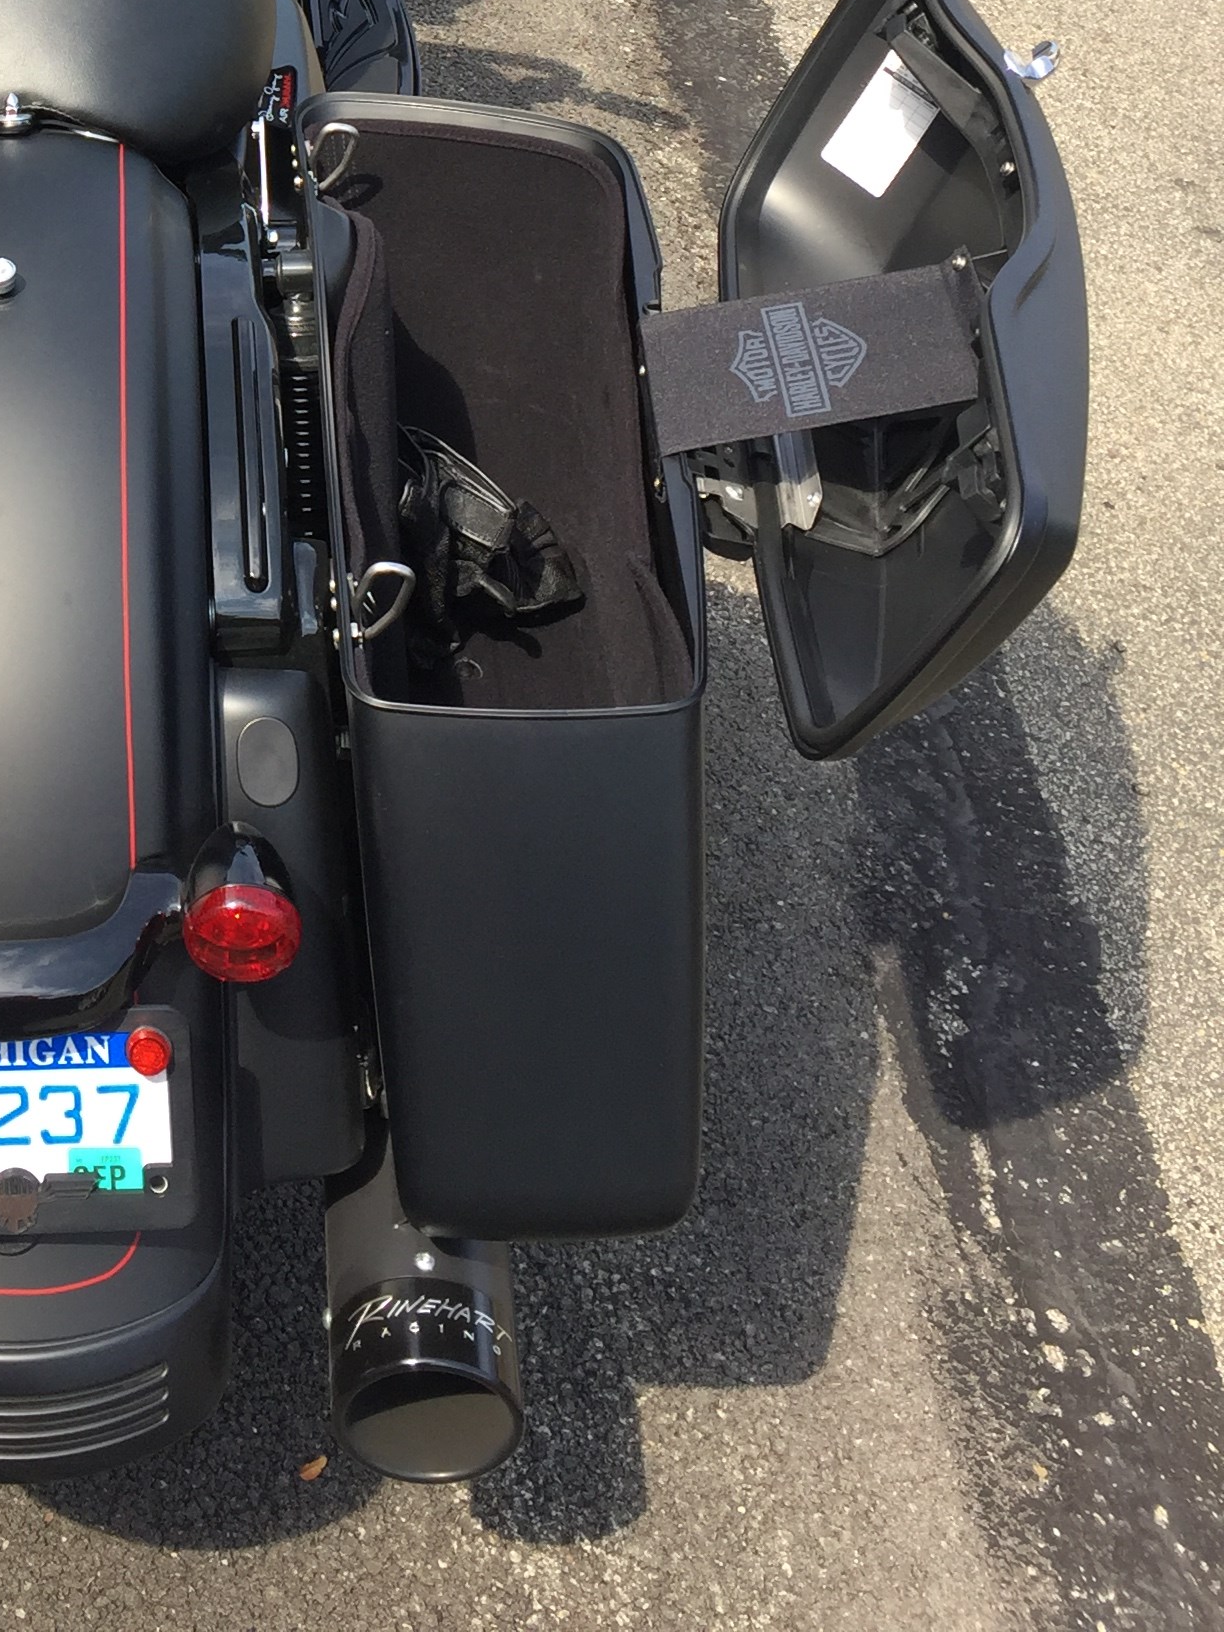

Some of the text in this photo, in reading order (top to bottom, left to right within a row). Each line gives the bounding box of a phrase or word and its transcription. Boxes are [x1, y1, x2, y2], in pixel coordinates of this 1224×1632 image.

[738, 338, 776, 392] MOTOR
[768, 308, 822, 410] HARLEY-DAVIDSON
[813, 326, 859, 380] CYCLES
[345, 1294, 513, 1351] RINEHART
